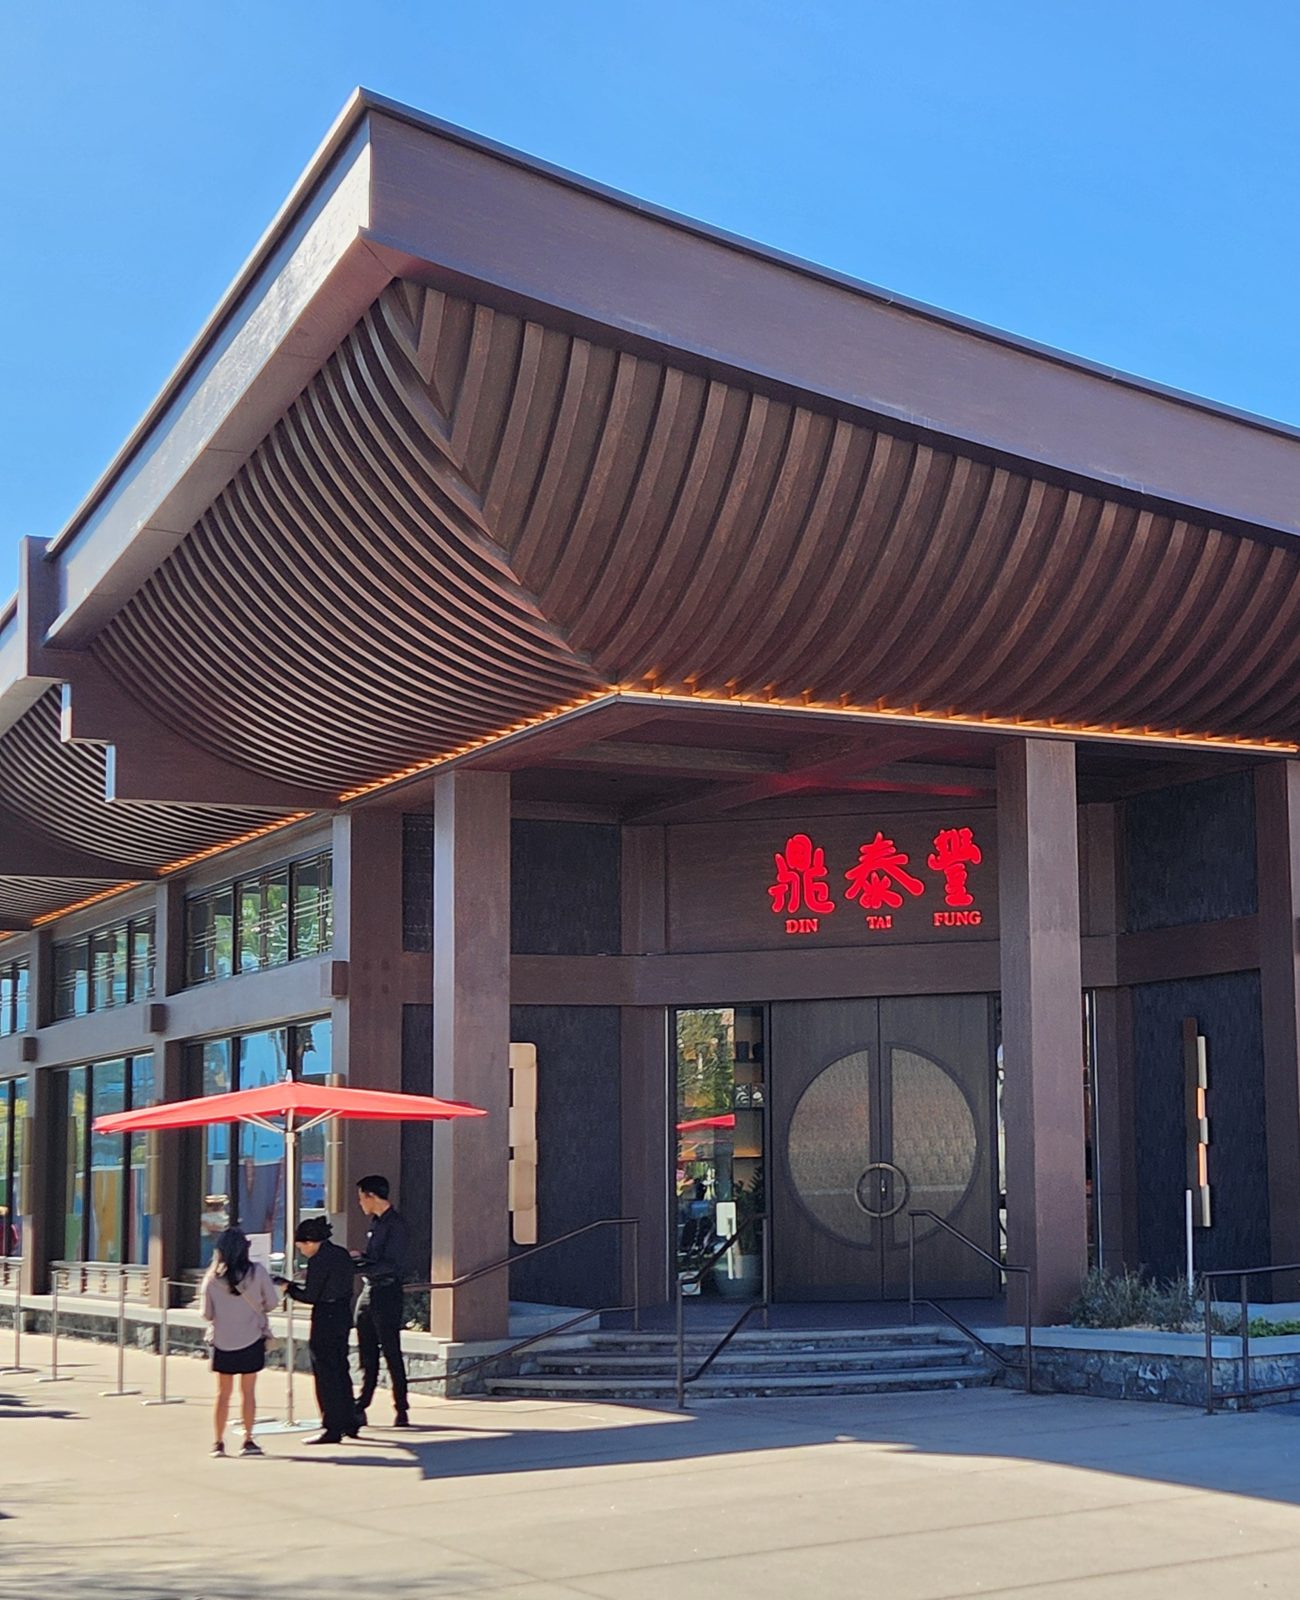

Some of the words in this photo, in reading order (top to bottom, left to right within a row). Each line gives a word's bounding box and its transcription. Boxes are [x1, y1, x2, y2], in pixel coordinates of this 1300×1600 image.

[785, 918, 819, 934] DIN
[866, 915, 892, 929] TAI
[933, 911, 982, 927] FUNG
